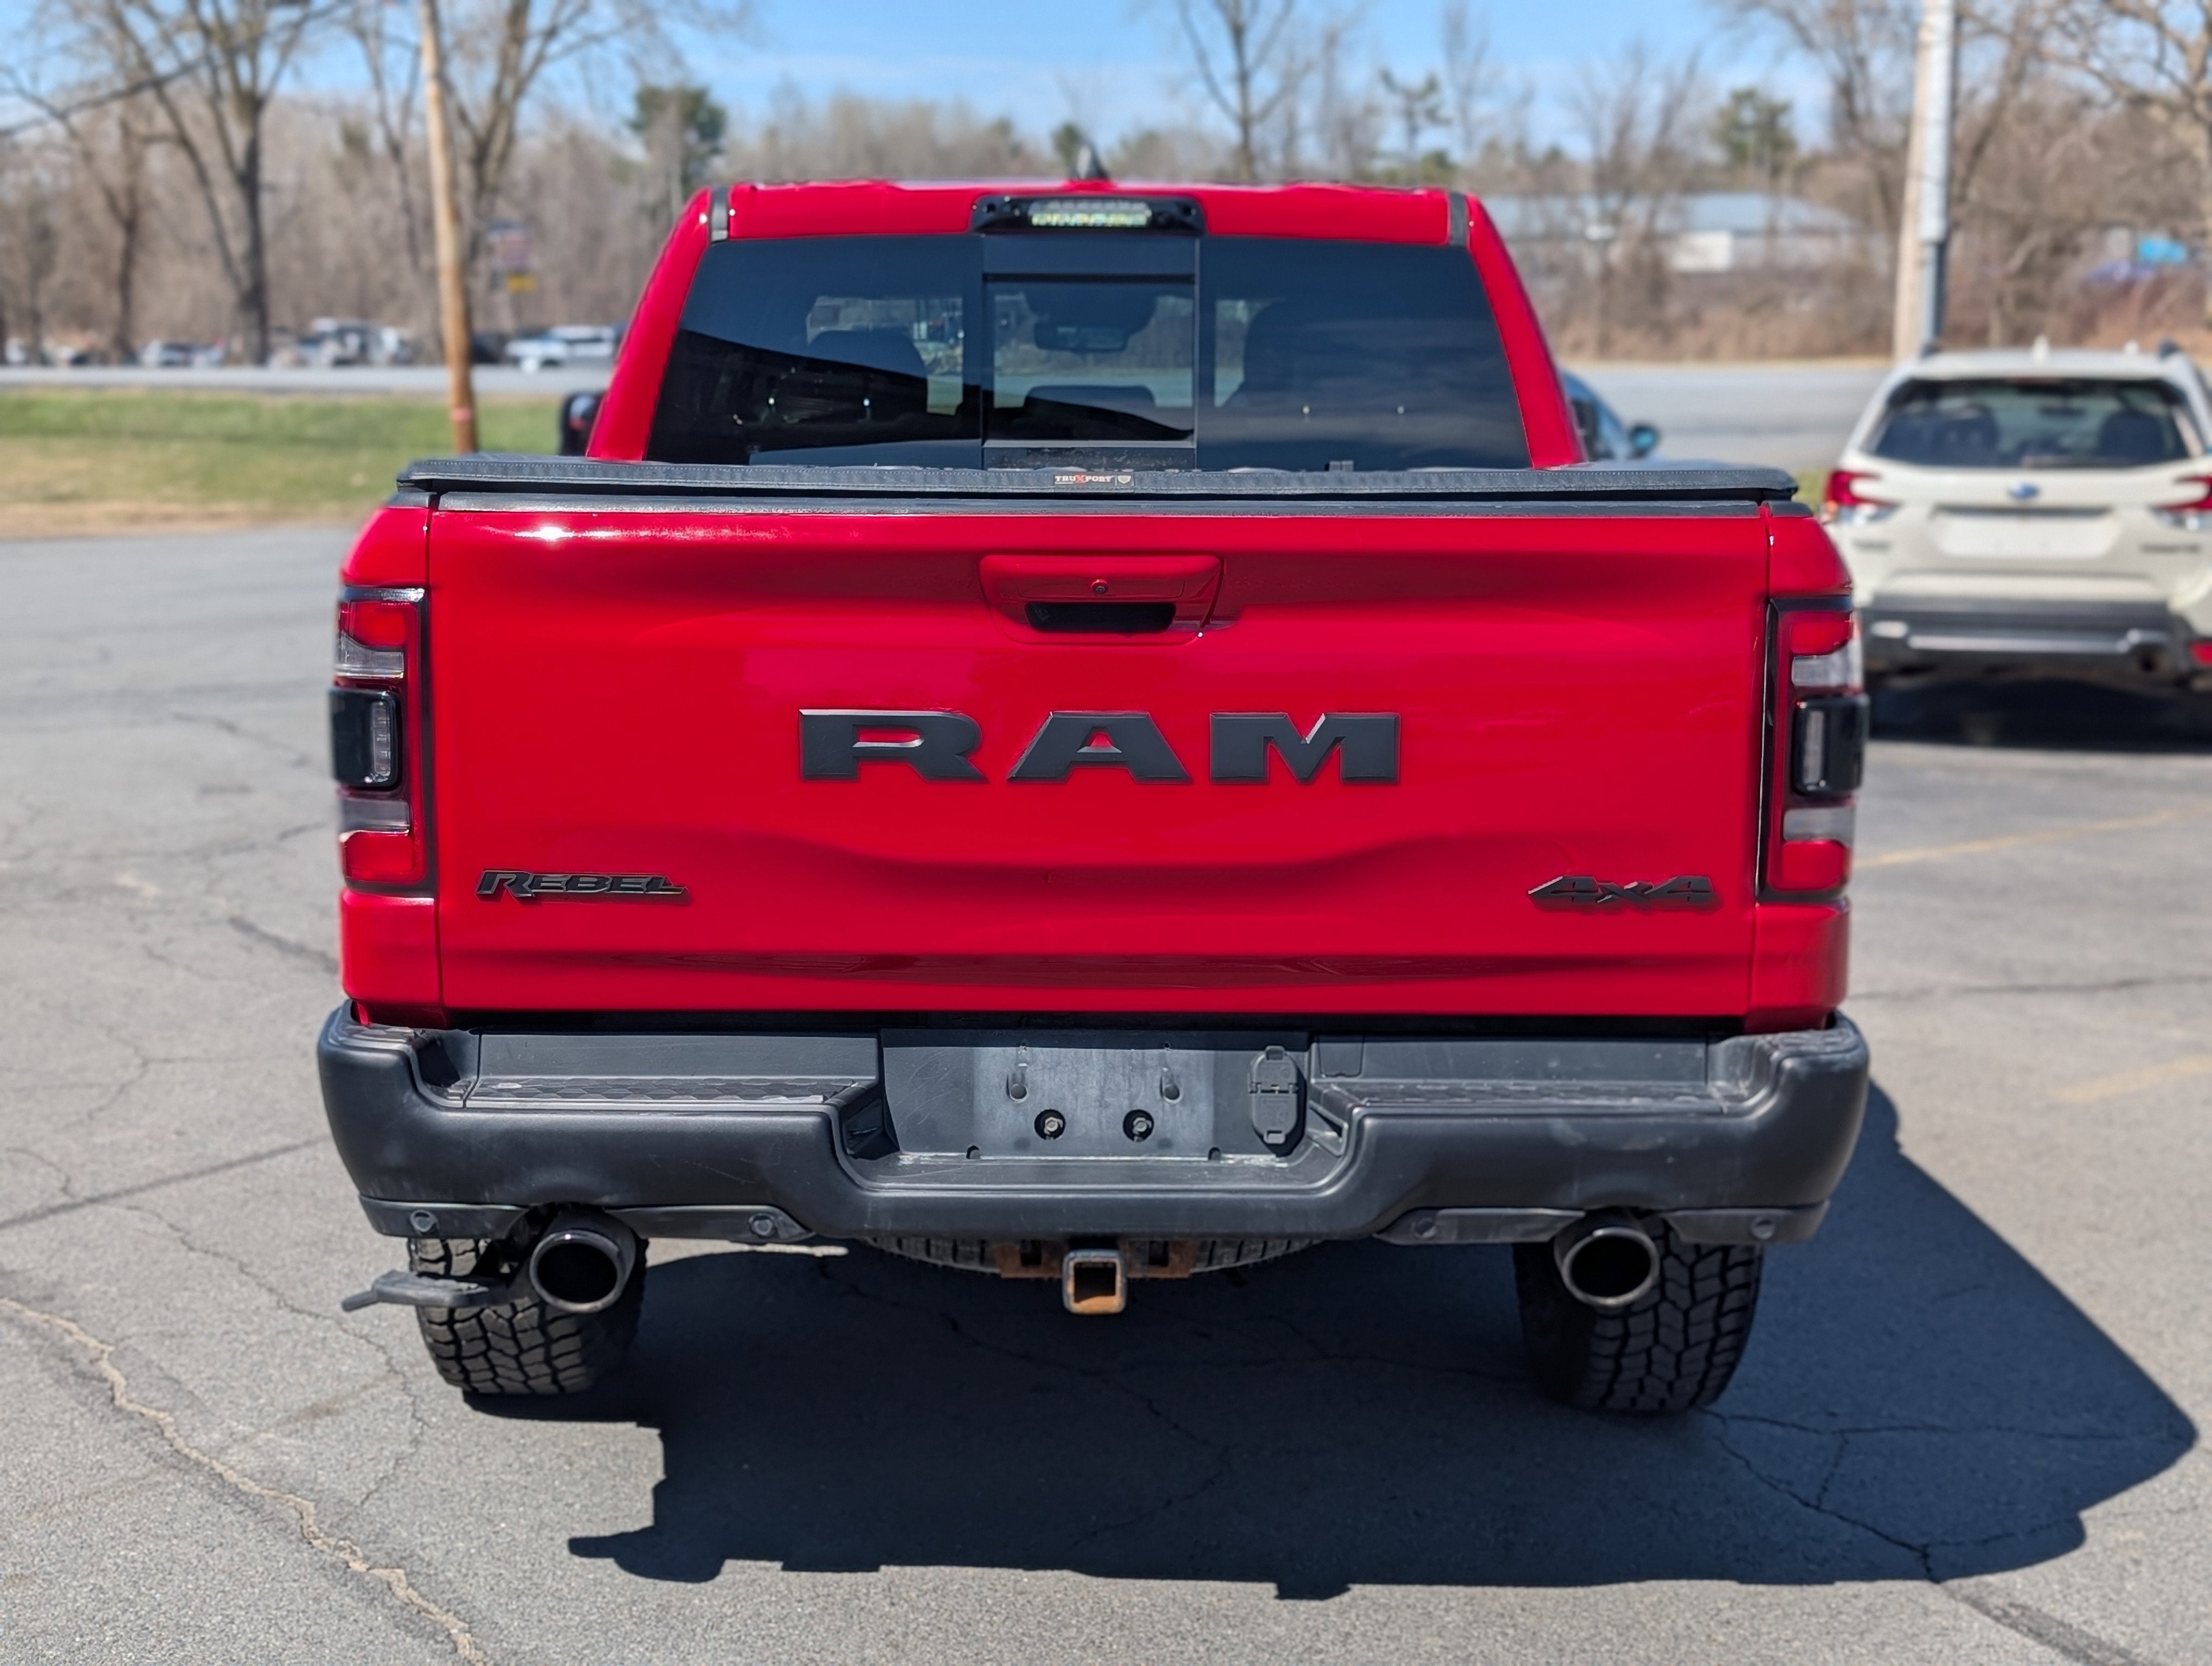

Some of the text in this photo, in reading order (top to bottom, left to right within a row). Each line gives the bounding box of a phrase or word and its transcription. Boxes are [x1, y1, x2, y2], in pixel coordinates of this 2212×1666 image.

[1054, 474, 1115, 483] TRUXPORT
[799, 709, 1401, 784] RAM
[475, 870, 687, 898] REBEL
